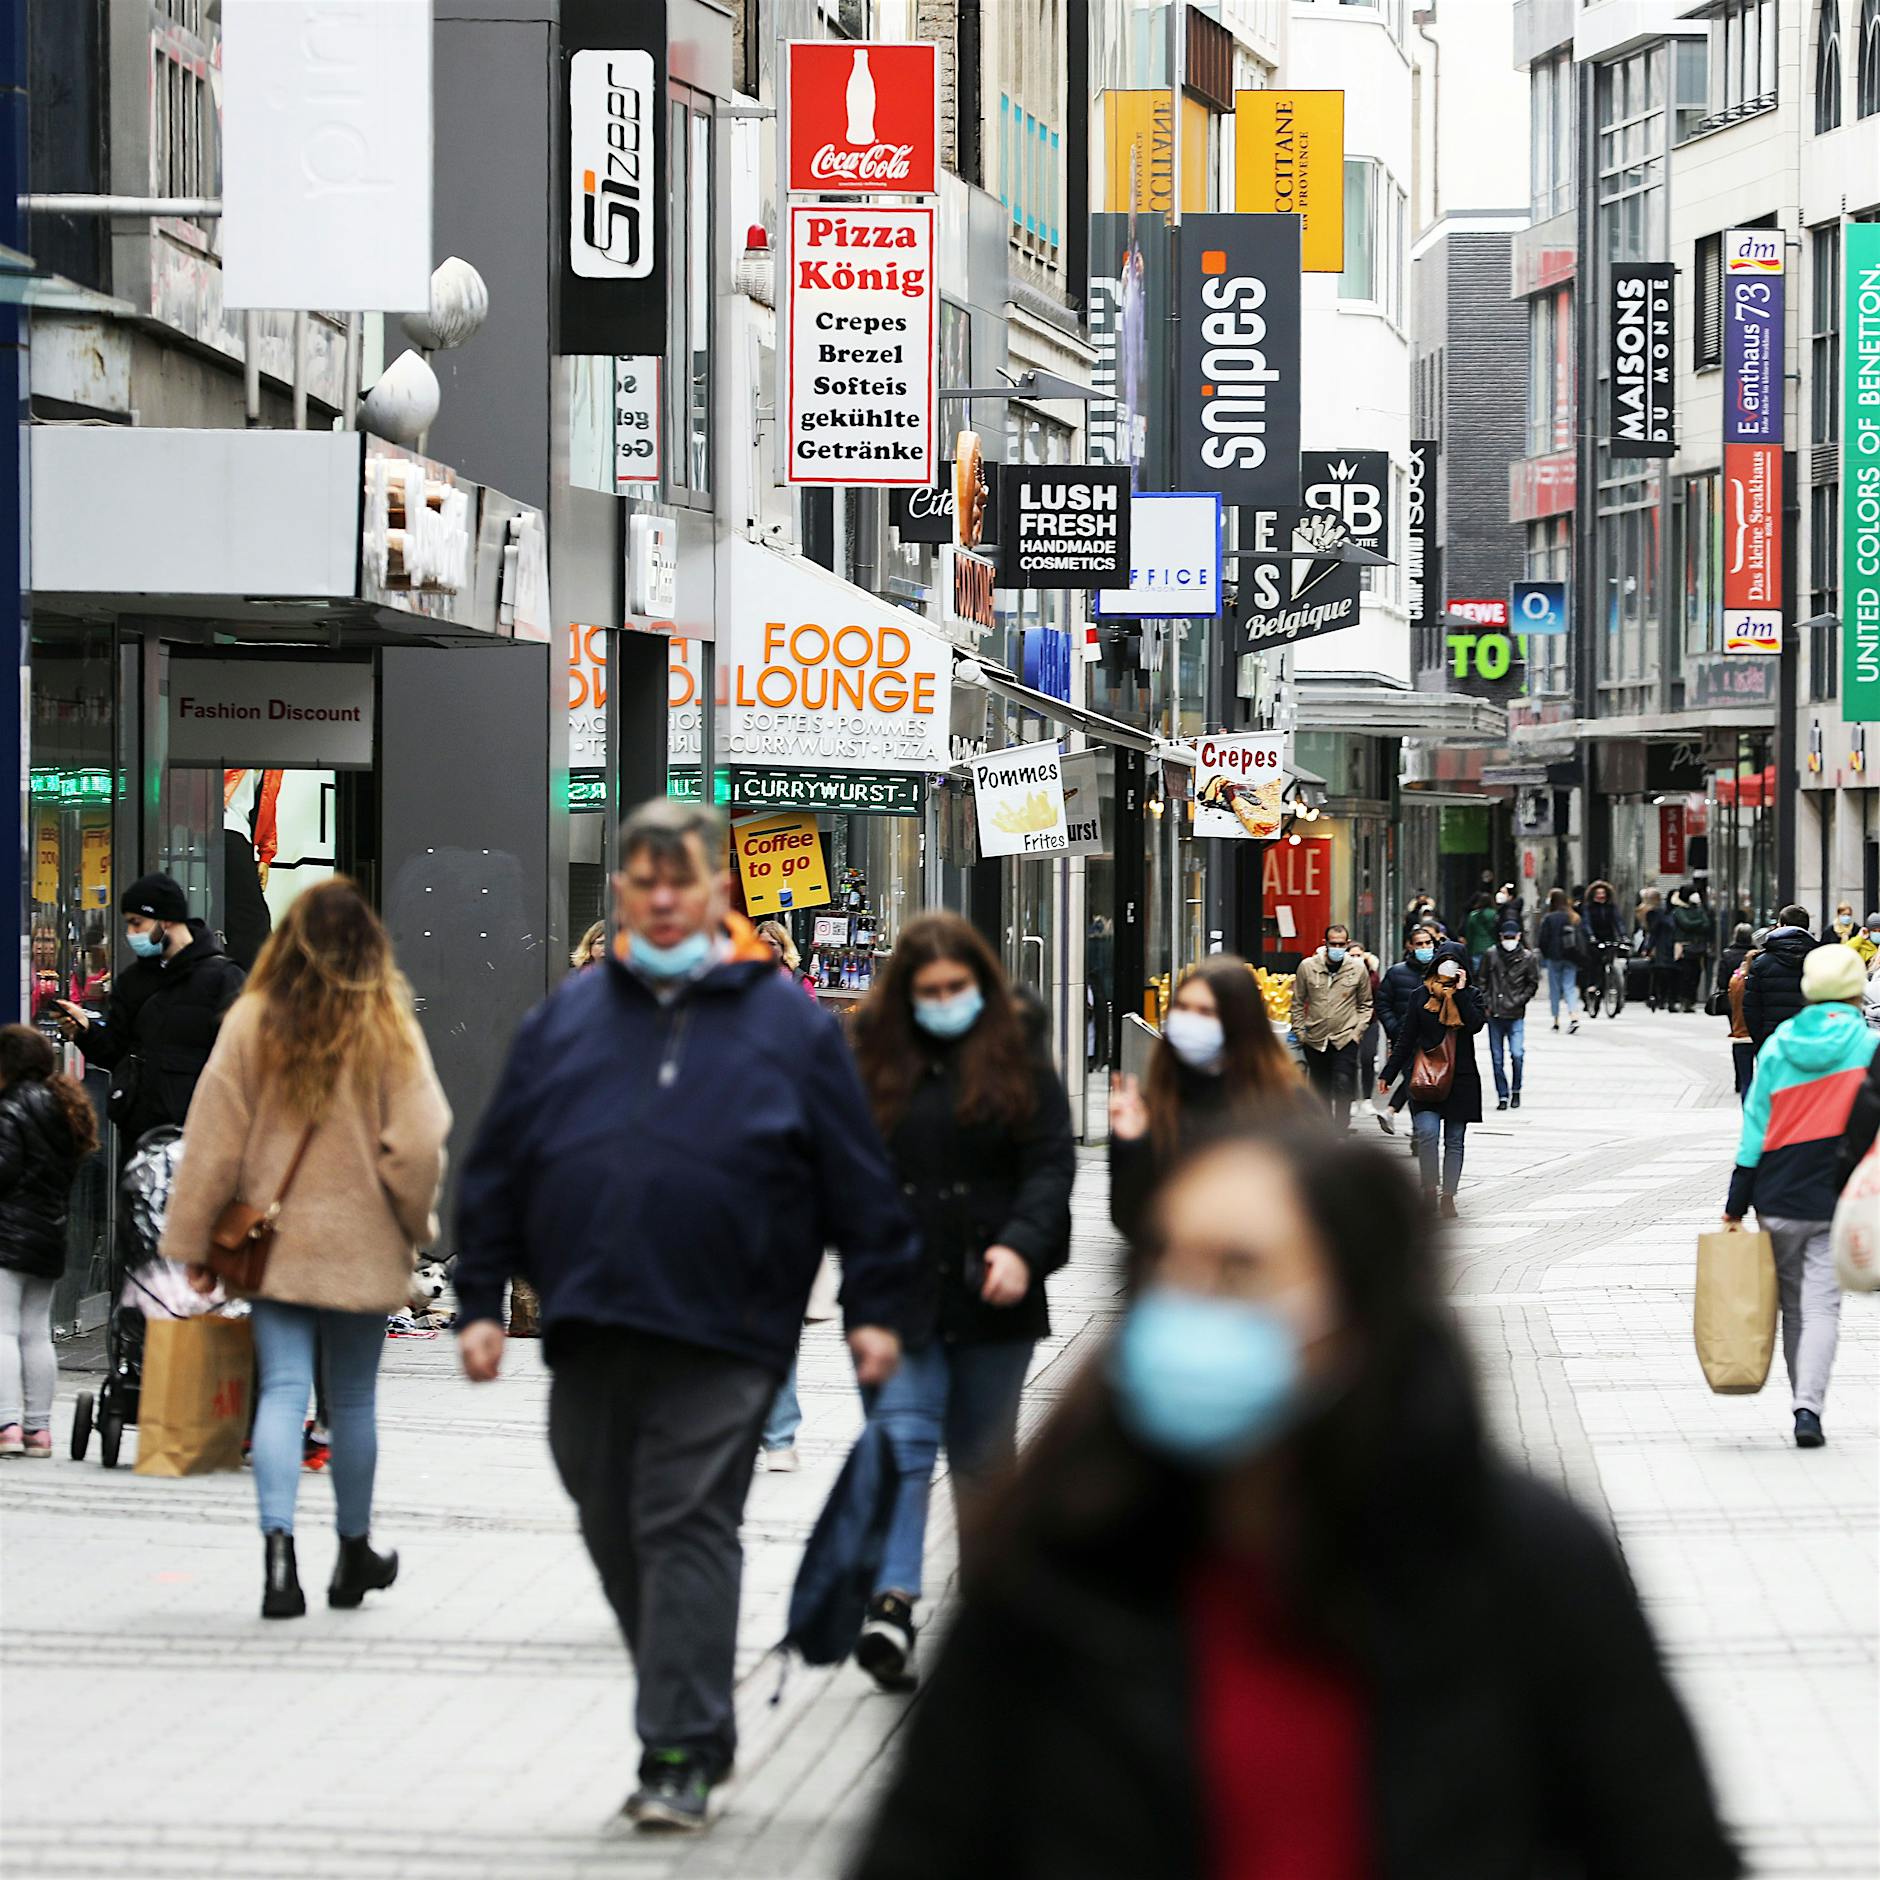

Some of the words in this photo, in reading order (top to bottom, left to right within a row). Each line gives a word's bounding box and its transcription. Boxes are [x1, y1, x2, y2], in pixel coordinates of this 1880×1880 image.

[1299, 131, 1308, 207] PROVENCE
[807, 218, 917, 248] Pizza
[1739, 236, 1776, 258] dm
[799, 261, 924, 297] König
[1735, 282, 1771, 322] 73
[816, 312, 907, 335] Crepes
[1653, 279, 1669, 384] MONDE
[818, 344, 903, 364] Brezel
[1616, 278, 1646, 440] MAISONS
[813, 376, 907, 395] Softeis
[1201, 276, 1280, 469] snipes
[801, 408, 920, 431] gekühlte
[1653, 406, 1669, 442] DU
[797, 440, 924, 460] Getränke
[1857, 418, 1880, 455] OF
[1020, 484, 1118, 511] LUSH
[1748, 450, 1764, 524] Steakhaus
[1020, 513, 1117, 537] FRESH
[1856, 467, 1880, 575] COLORS
[1020, 539, 1117, 554] HANDMADE
[1748, 527, 1764, 569] kleine
[1020, 556, 1116, 571] COSMETICS
[1748, 572, 1764, 601] Das
[1245, 597, 1354, 642] Belgique
[1736, 616, 1773, 637] dm
[764, 622, 911, 668] FOOD
[1856, 588, 1880, 683] UNITED
[736, 664, 936, 714] LOUNGE
[179, 697, 261, 719] Fashion
[268, 699, 361, 722] Discount
[837, 716, 928, 737] POMMES
[730, 734, 870, 758] CURRYWURST
[882, 740, 939, 761] PIZZA
[977, 763, 1058, 790] Pommes
[743, 833, 814, 857] Coffee
[1024, 834, 1065, 851] Frites
[748, 861, 772, 878] to
[782, 856, 811, 877] go
[1262, 848, 1321, 896] ALE
